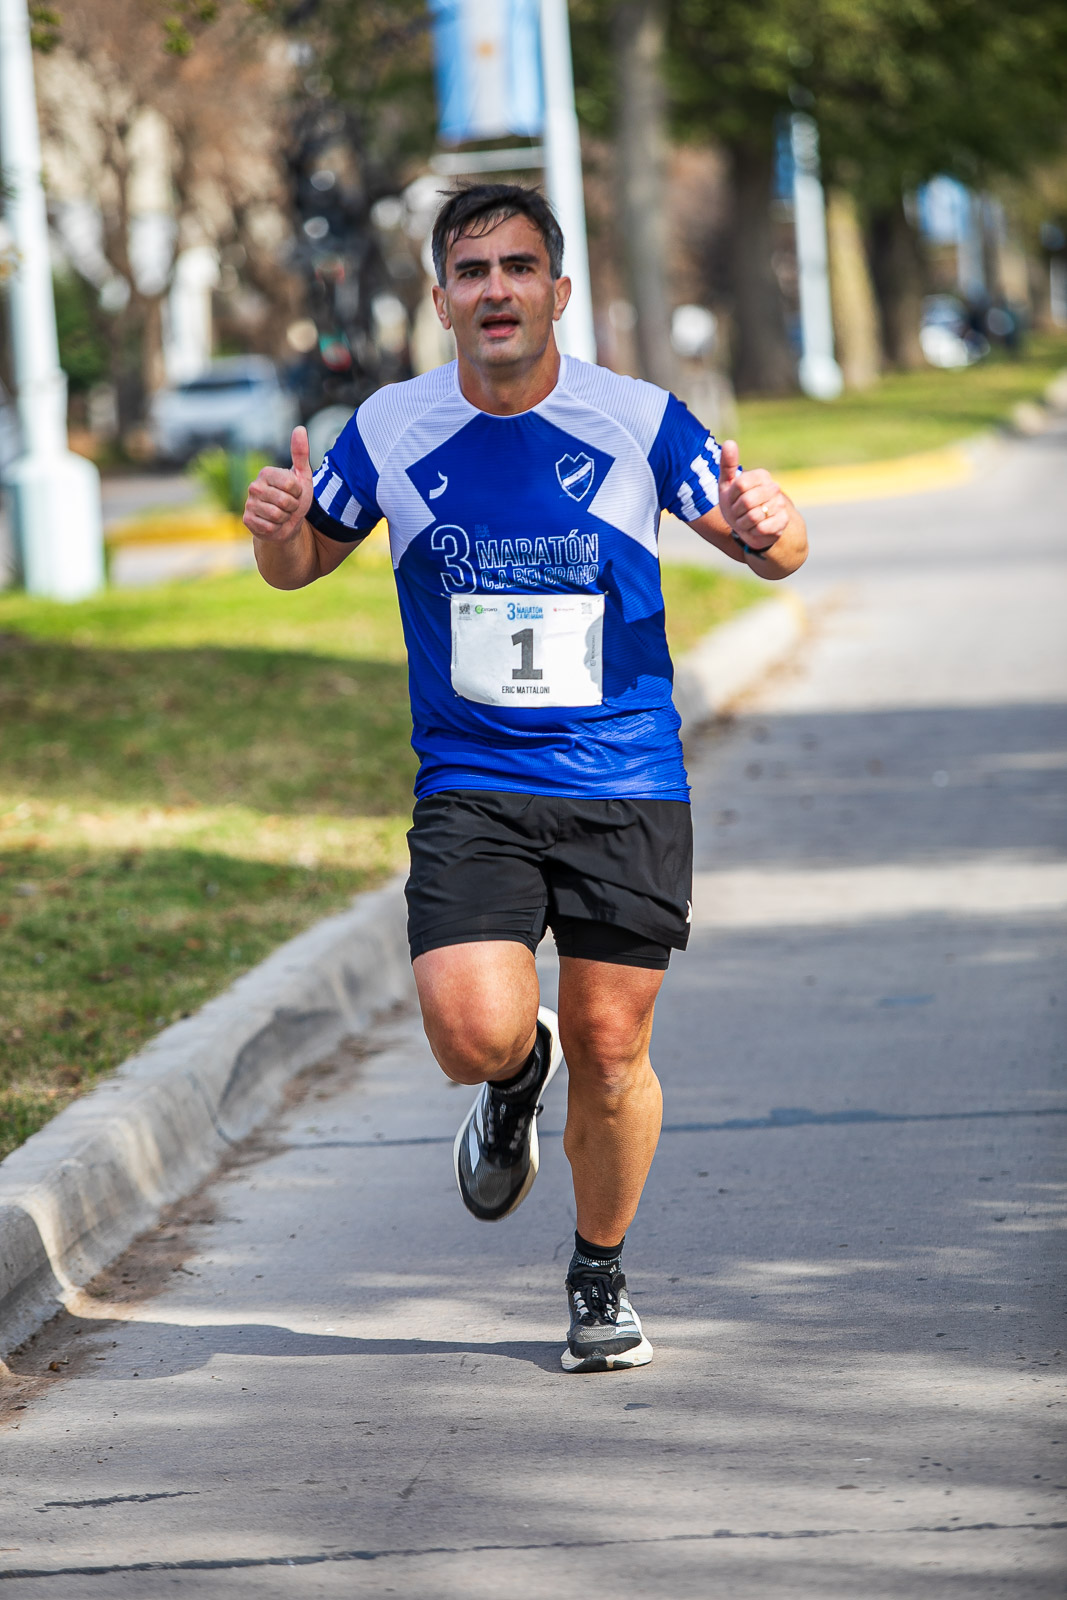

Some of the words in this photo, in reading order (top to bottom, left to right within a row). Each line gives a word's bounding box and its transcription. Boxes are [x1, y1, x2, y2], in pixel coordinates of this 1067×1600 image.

[430, 524, 477, 595] 3
[475, 529, 599, 570] MARATÓN
[507, 602, 516, 621] 3
[511, 628, 543, 680] 1
[501, 685, 515, 694] ERIC
[516, 685, 550, 694] MATTALONI
